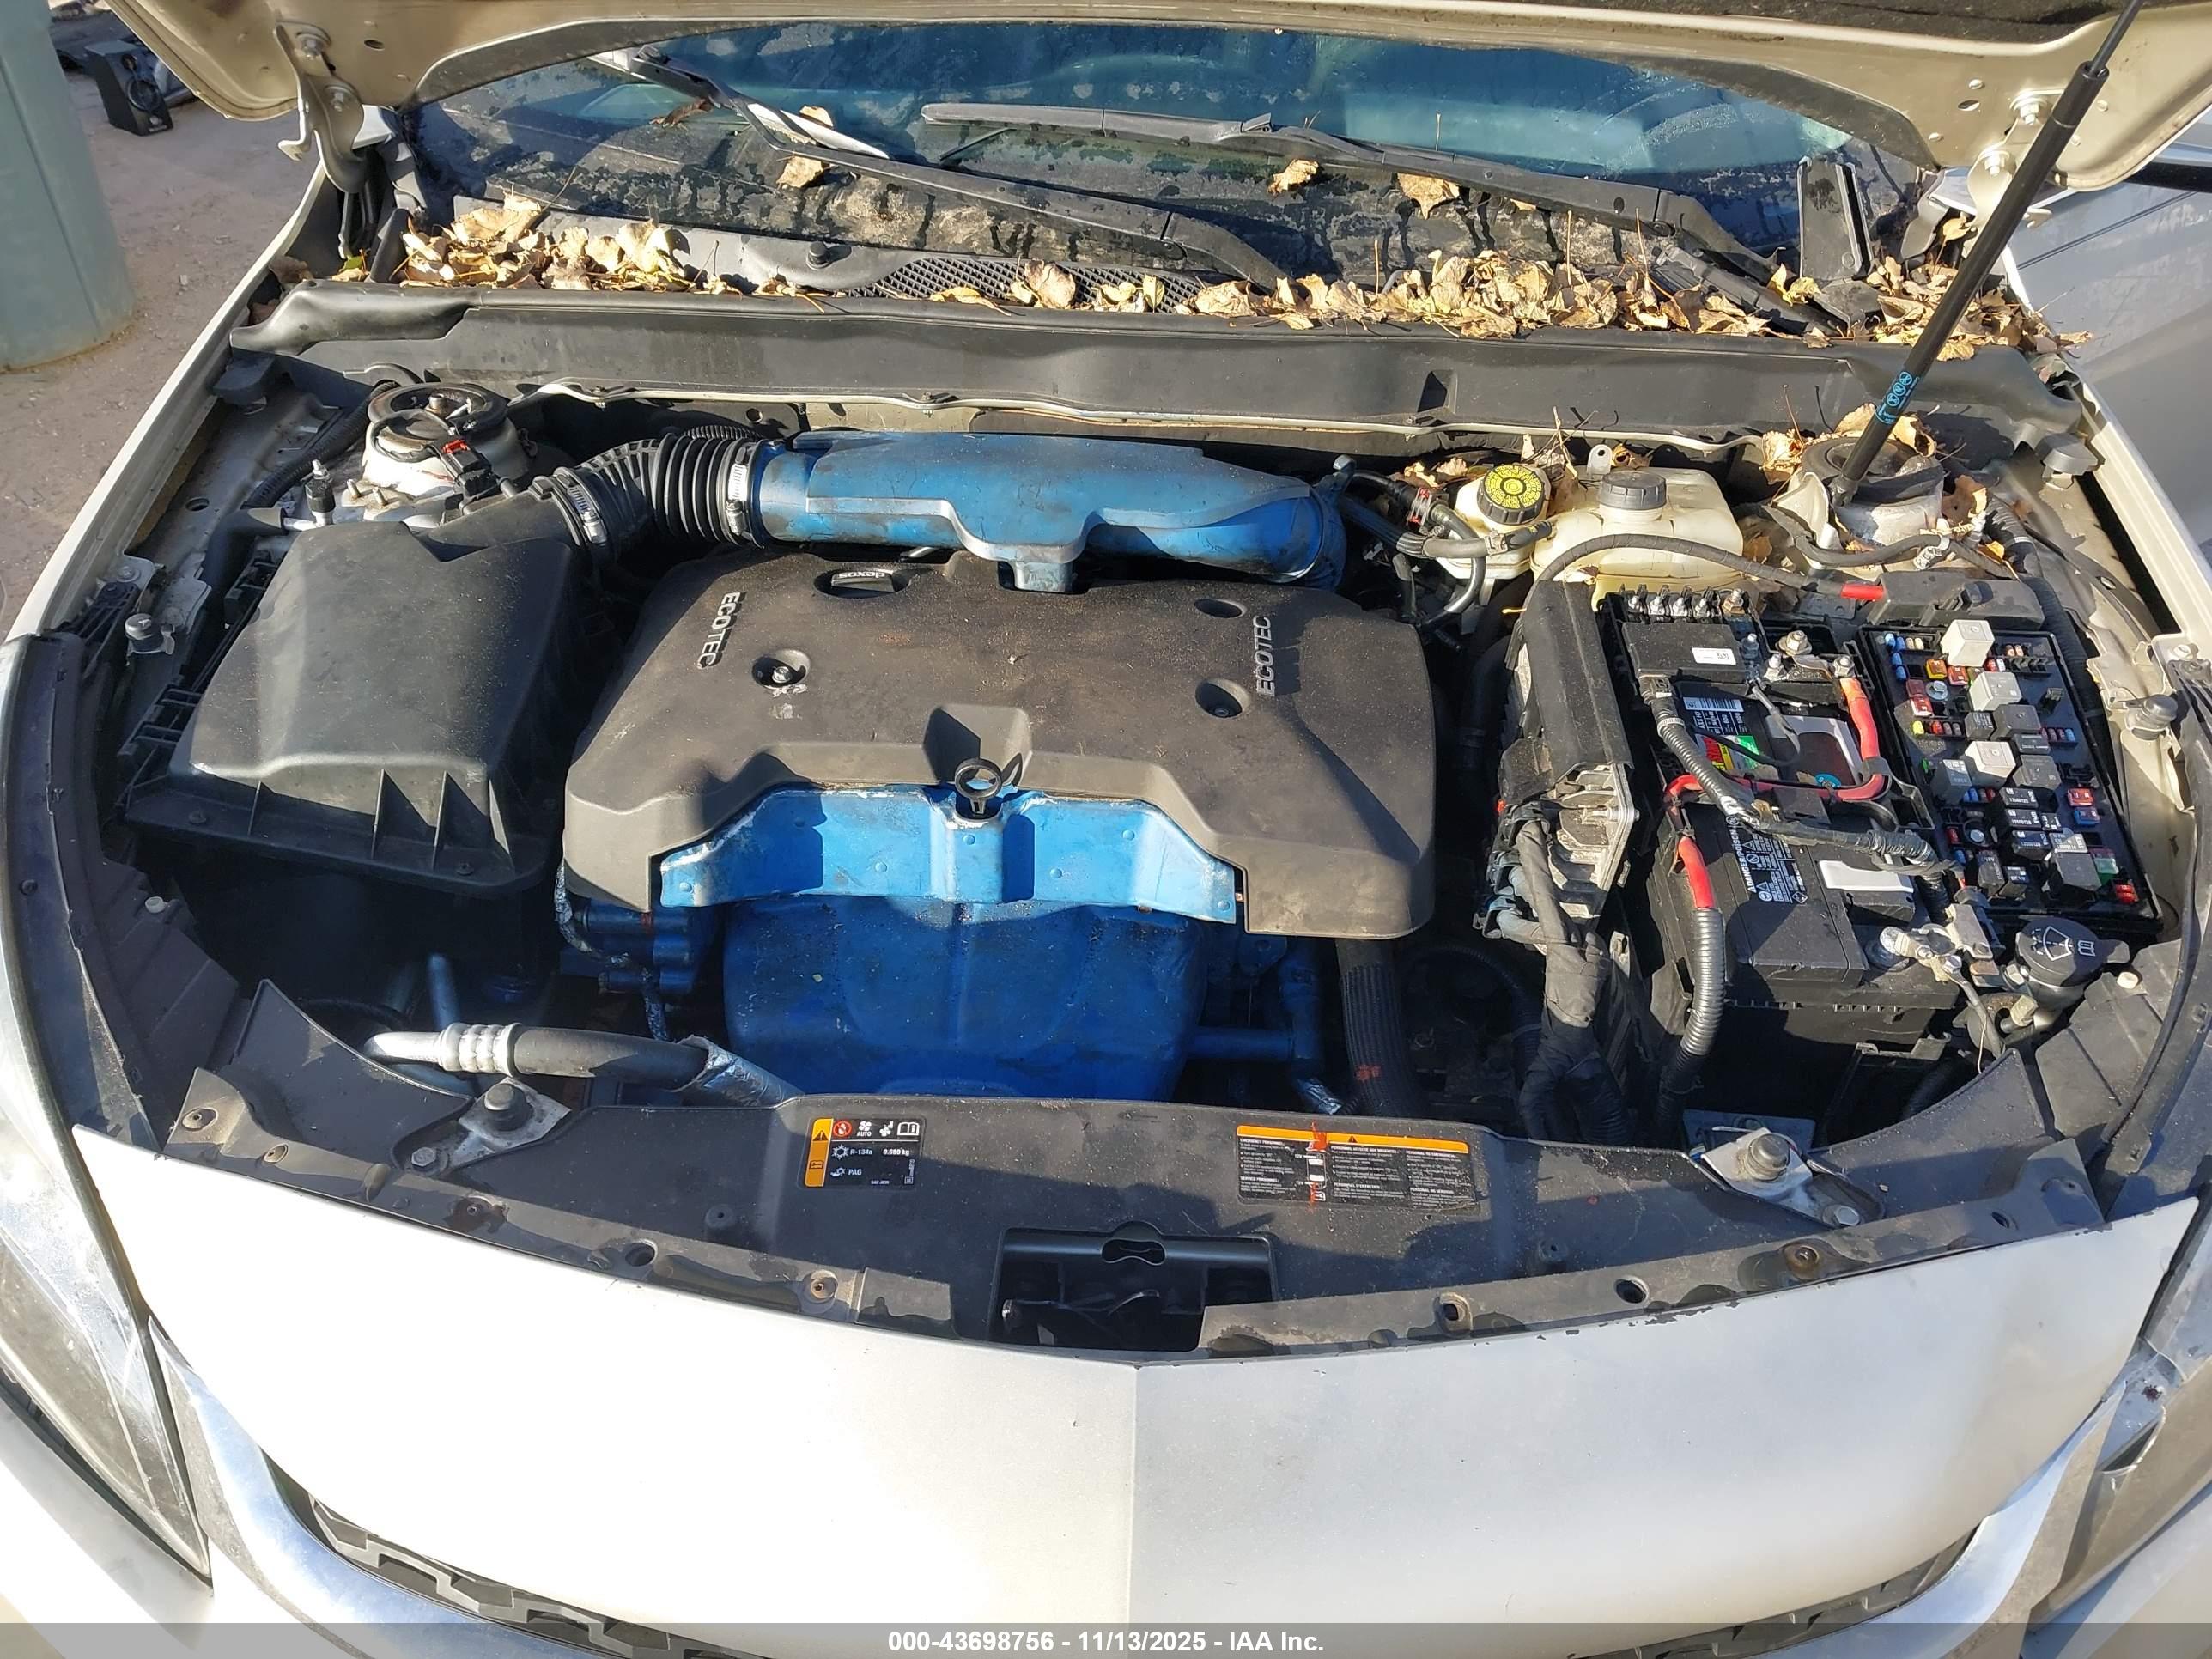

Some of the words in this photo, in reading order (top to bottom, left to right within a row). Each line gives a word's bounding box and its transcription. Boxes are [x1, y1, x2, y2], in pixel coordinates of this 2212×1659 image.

[696, 592, 740, 670] ECOTEC
[1253, 615, 1275, 696] ECOTEC
[902, 1148, 910, 1157] kg
